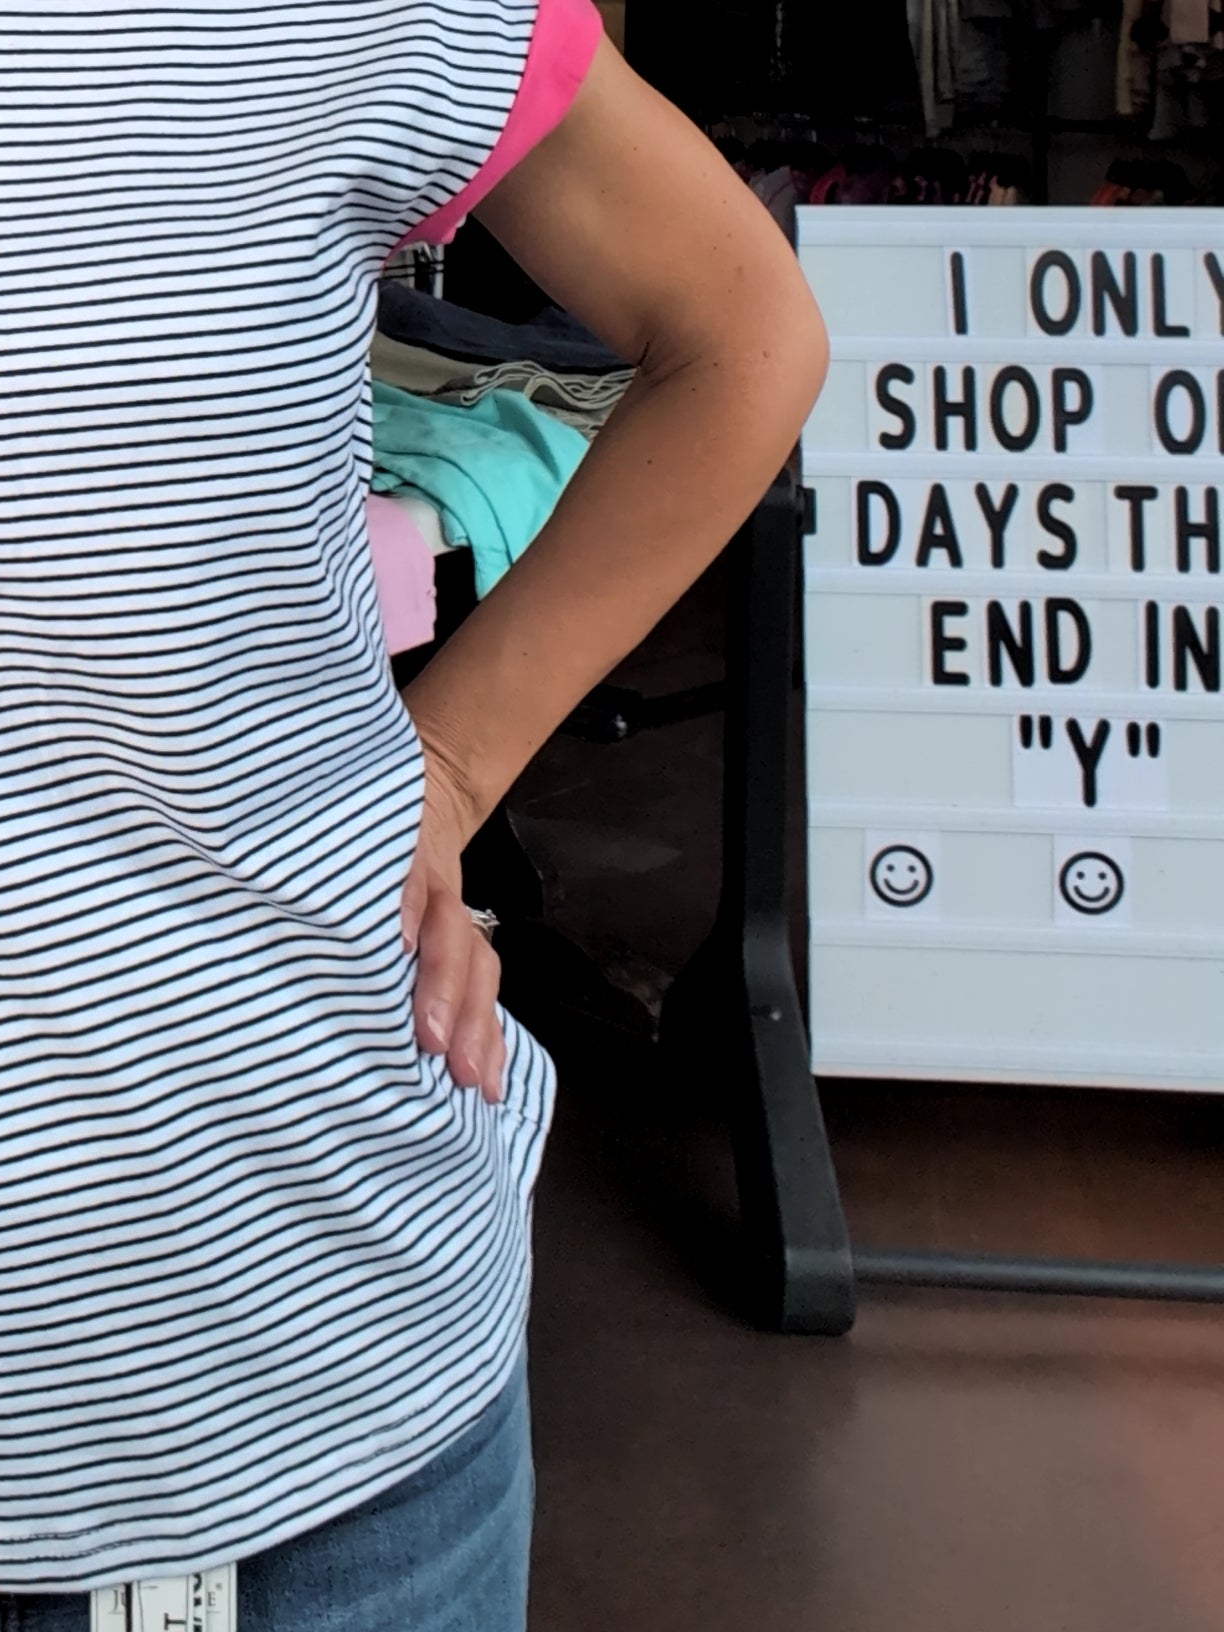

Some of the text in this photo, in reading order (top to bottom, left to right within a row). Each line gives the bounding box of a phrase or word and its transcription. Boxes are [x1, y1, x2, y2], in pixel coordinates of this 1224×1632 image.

[950, 251, 968, 336] I
[875, 363, 1224, 455] SHOP O
[856, 480, 1077, 571] DAYS
[930, 597, 1221, 693] END IN
[1019, 714, 1161, 808] "Y"
